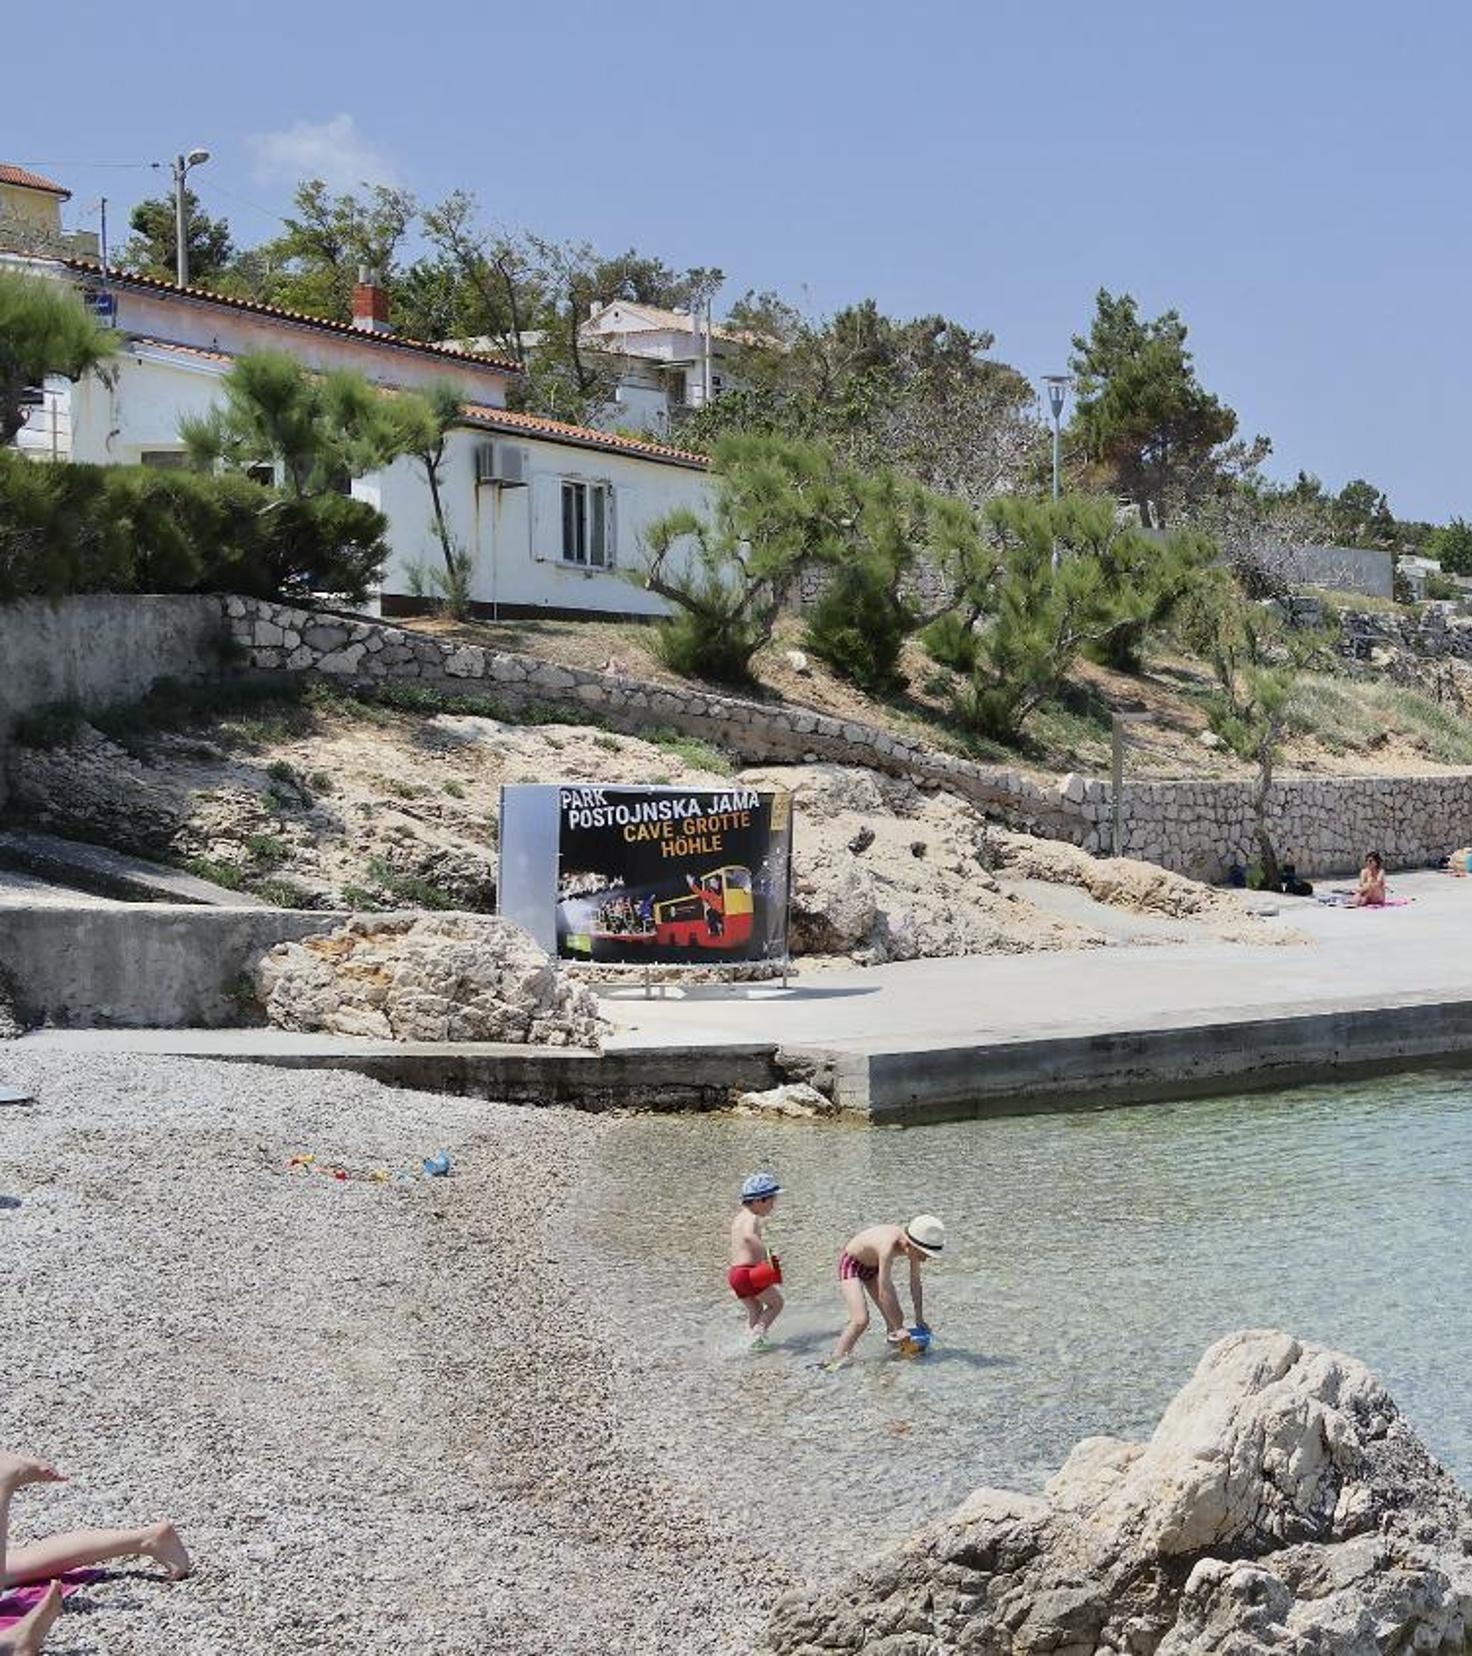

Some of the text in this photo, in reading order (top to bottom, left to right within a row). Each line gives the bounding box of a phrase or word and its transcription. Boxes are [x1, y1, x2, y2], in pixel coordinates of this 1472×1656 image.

[560, 788, 608, 809] PARK
[568, 799, 702, 830] POSTOJNSKA
[707, 790, 760, 814] JAMA
[623, 821, 674, 842] CAVE
[683, 811, 751, 836] GROTTE
[661, 834, 722, 858] HÖHLE
